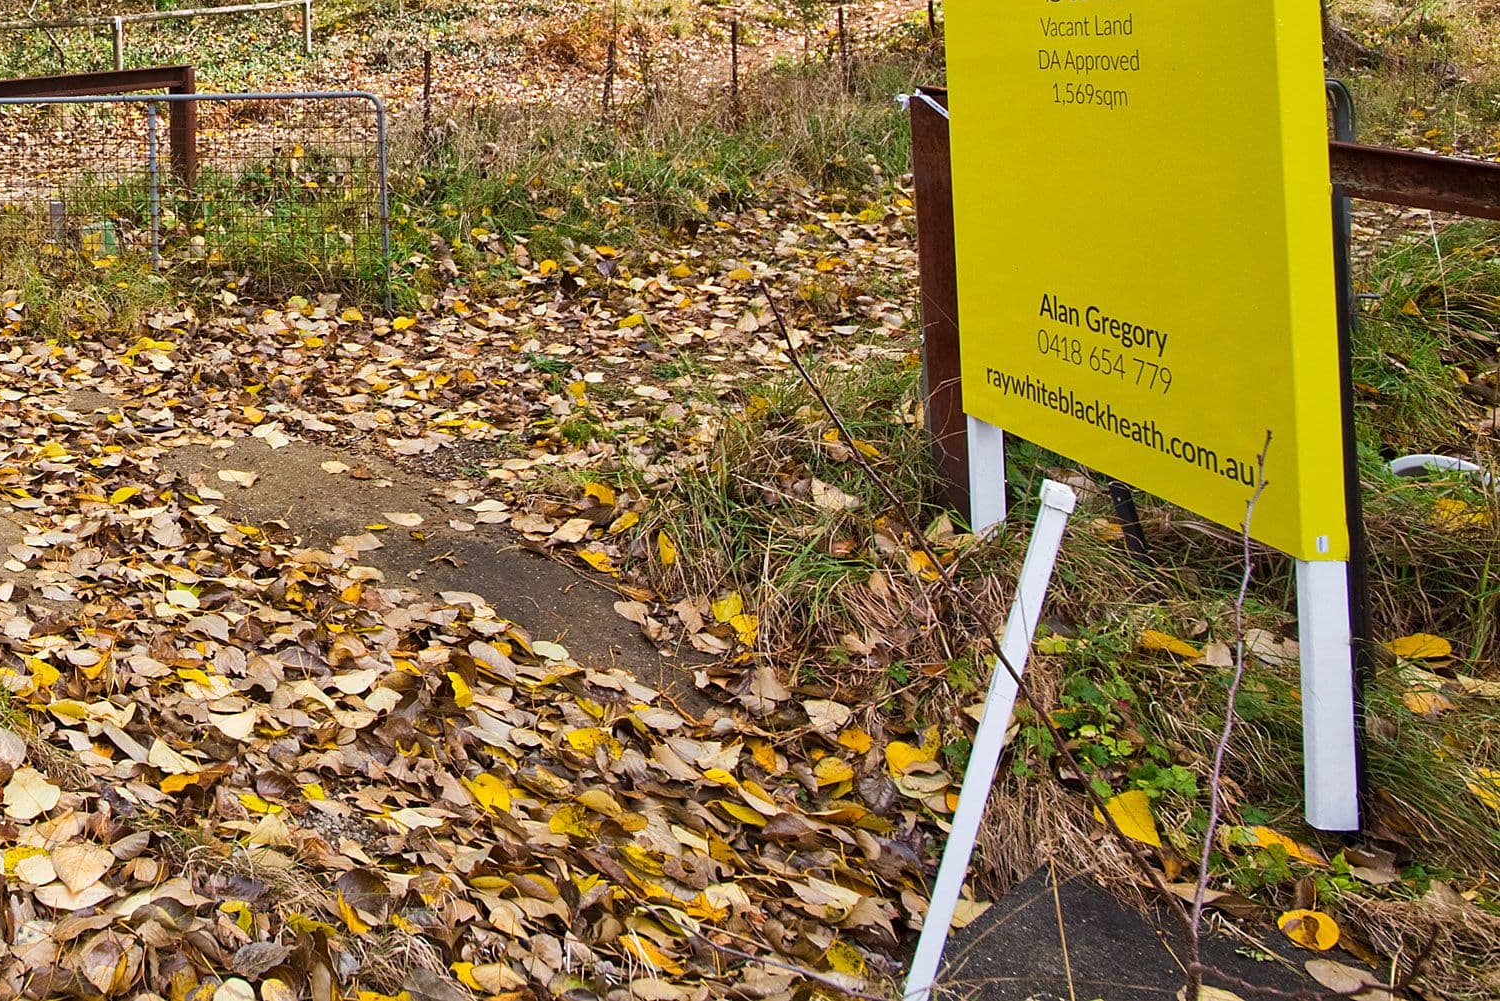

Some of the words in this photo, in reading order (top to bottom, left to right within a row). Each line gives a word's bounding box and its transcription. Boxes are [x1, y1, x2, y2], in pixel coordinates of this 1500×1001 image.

[1040, 16, 1090, 37] Vacant
[1095, 13, 1133, 36] Land
[1038, 49, 1061, 70] DA
[1064, 49, 1140, 75] Approved
[1052, 83, 1128, 110] 1,569sqm
[1039, 293, 1079, 327] Alan
[1085, 306, 1168, 357] Gregory
[1037, 329, 1082, 365] 0418
[1089, 345, 1126, 380] 654
[1132, 357, 1172, 395] 779
[986, 365, 1255, 488] raywhiteblackheath.com.au
